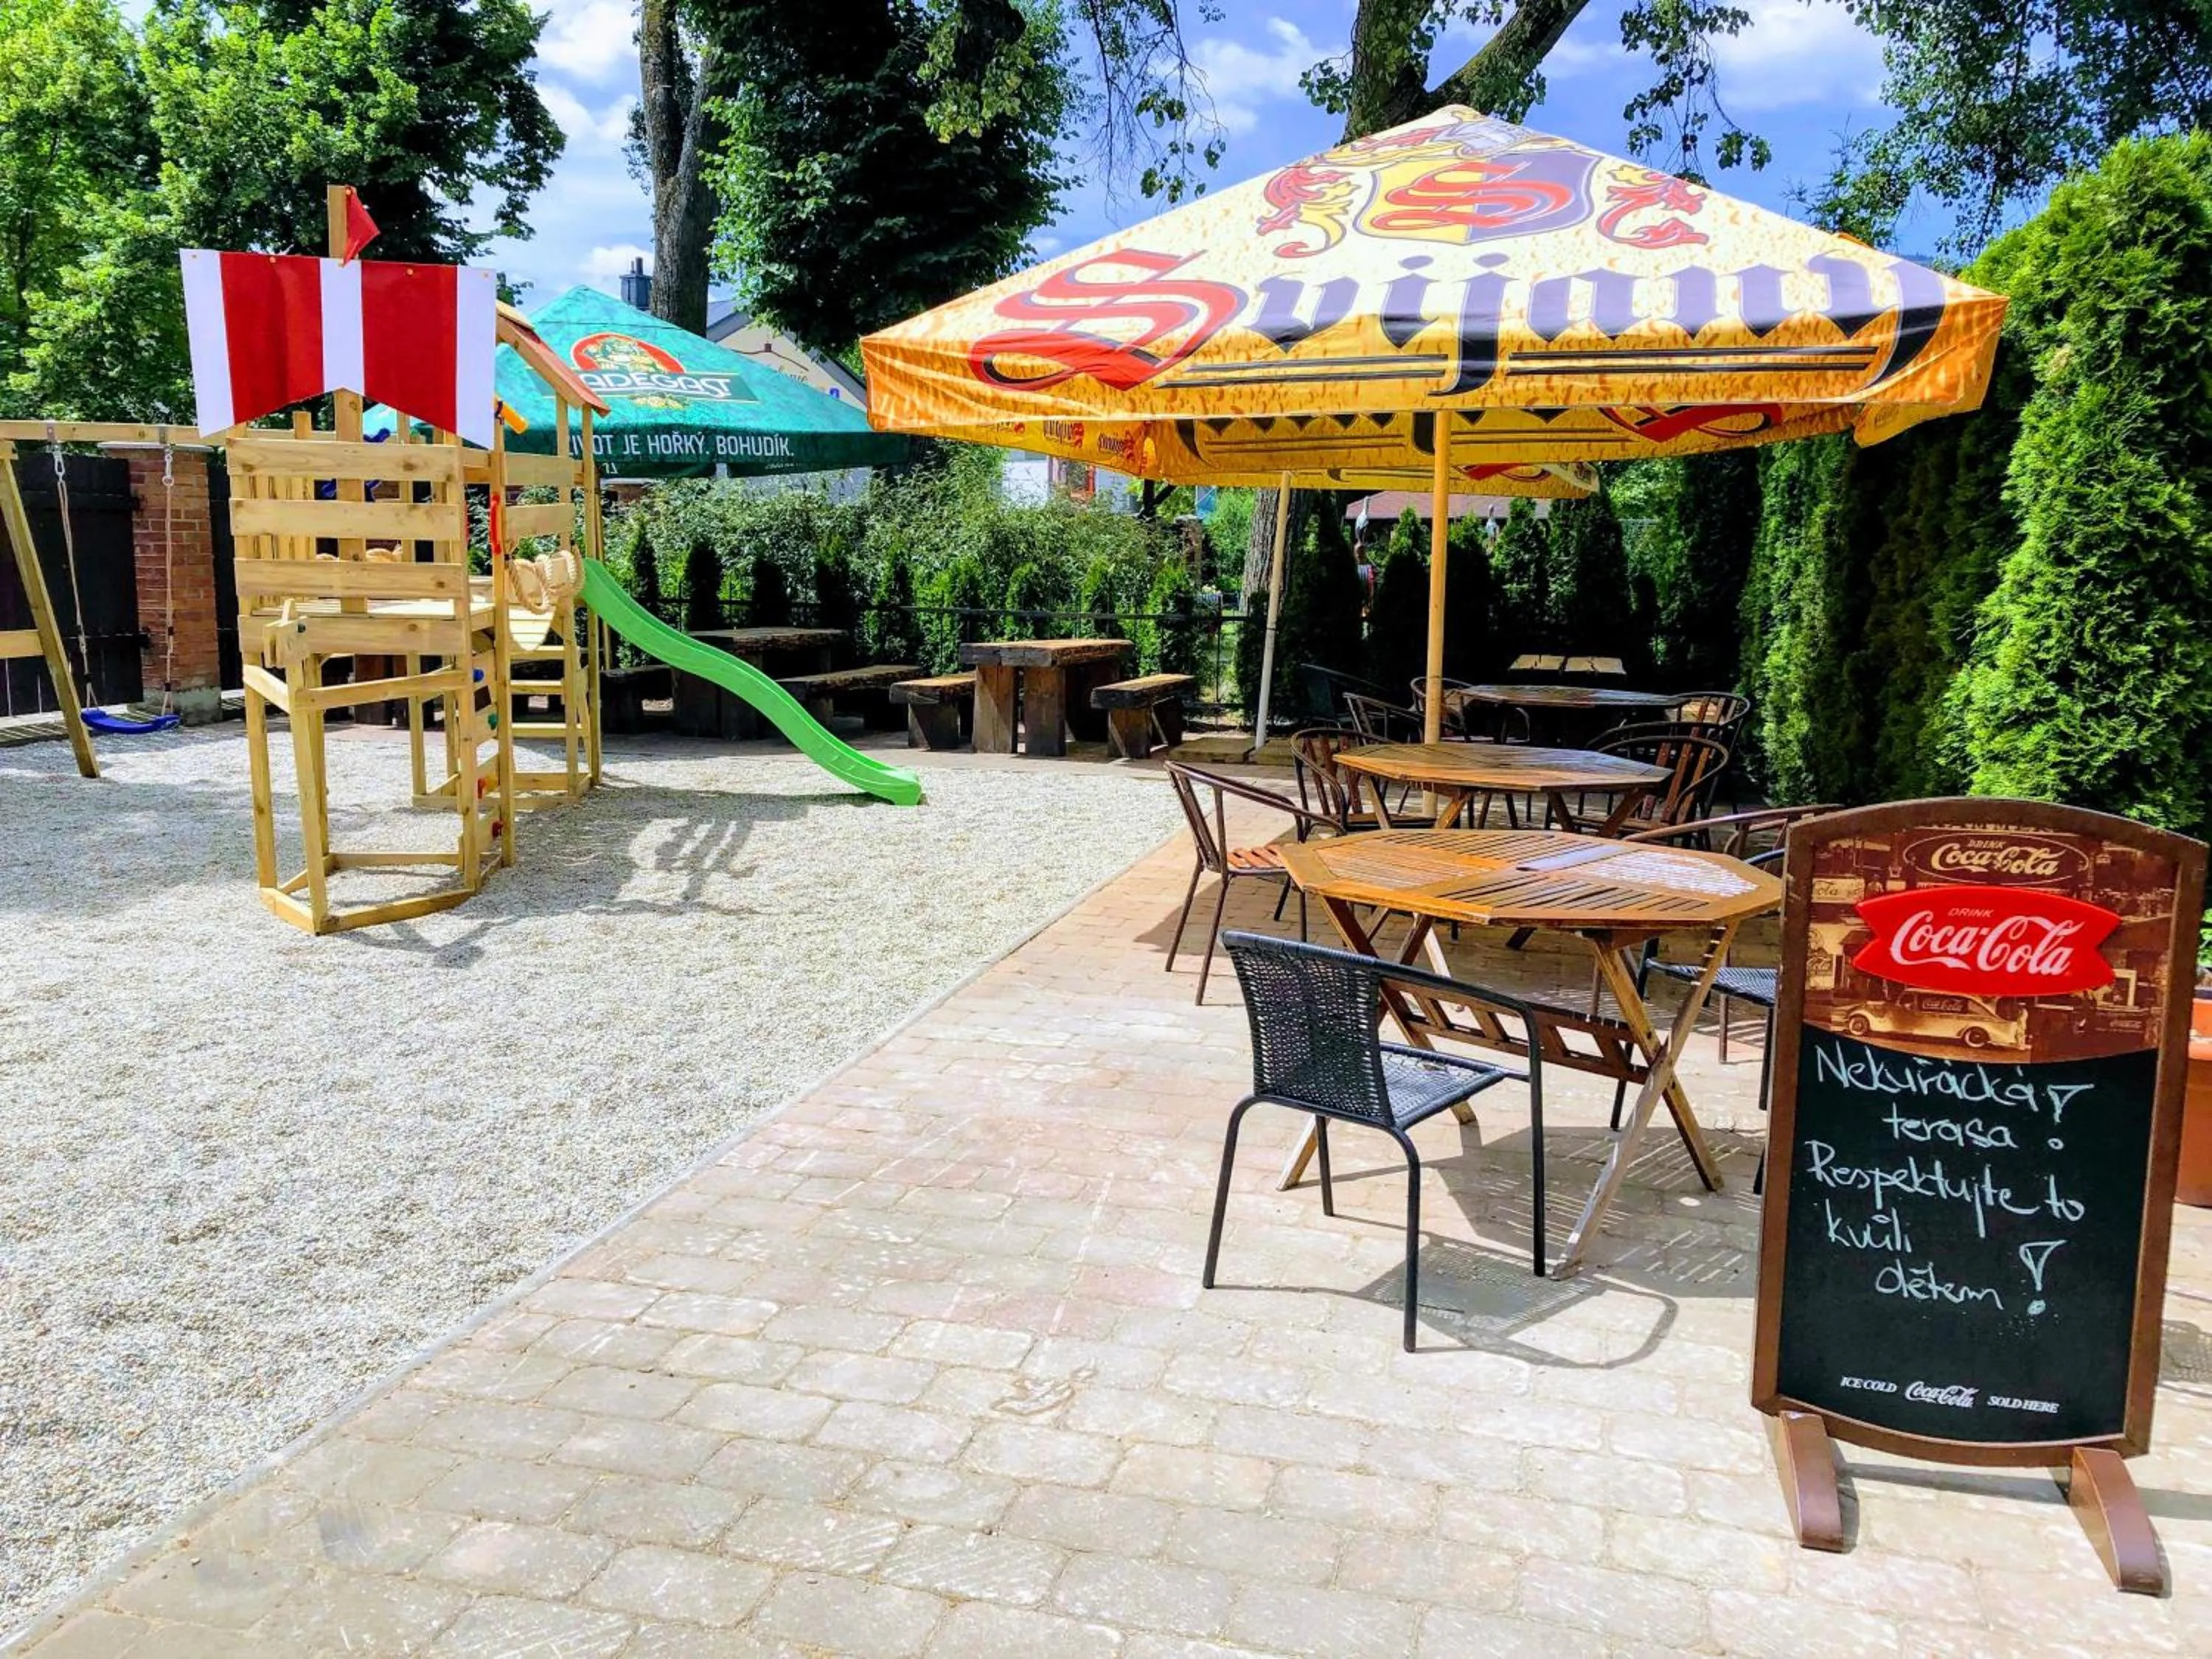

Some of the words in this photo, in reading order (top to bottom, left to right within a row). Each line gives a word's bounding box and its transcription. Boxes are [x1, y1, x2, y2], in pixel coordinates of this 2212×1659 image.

[969, 248, 1947, 398] Svijany
[578, 371, 733, 399] ADEGAST
[623, 434, 641, 456] JE
[648, 430, 710, 456] HOŘKÝ.
[717, 433, 795, 457] BOHUDÍK.
[1930, 843, 2067, 875] Coca-Cola
[1966, 839, 2006, 849] DRINK
[1947, 908, 1994, 918] DRINK
[1889, 910, 2085, 975] Coca-Cola
[1882, 1102, 2019, 1149] terasa
[2046, 1174, 2085, 1222] to
[1840, 1376, 1862, 1388] ICE
[1863, 1379, 1897, 1393] COLD
[1905, 1380, 1980, 1408] Coca-Cola
[1987, 1395, 2023, 1409] SOLD
[2023, 1399, 2060, 1413] HERE
